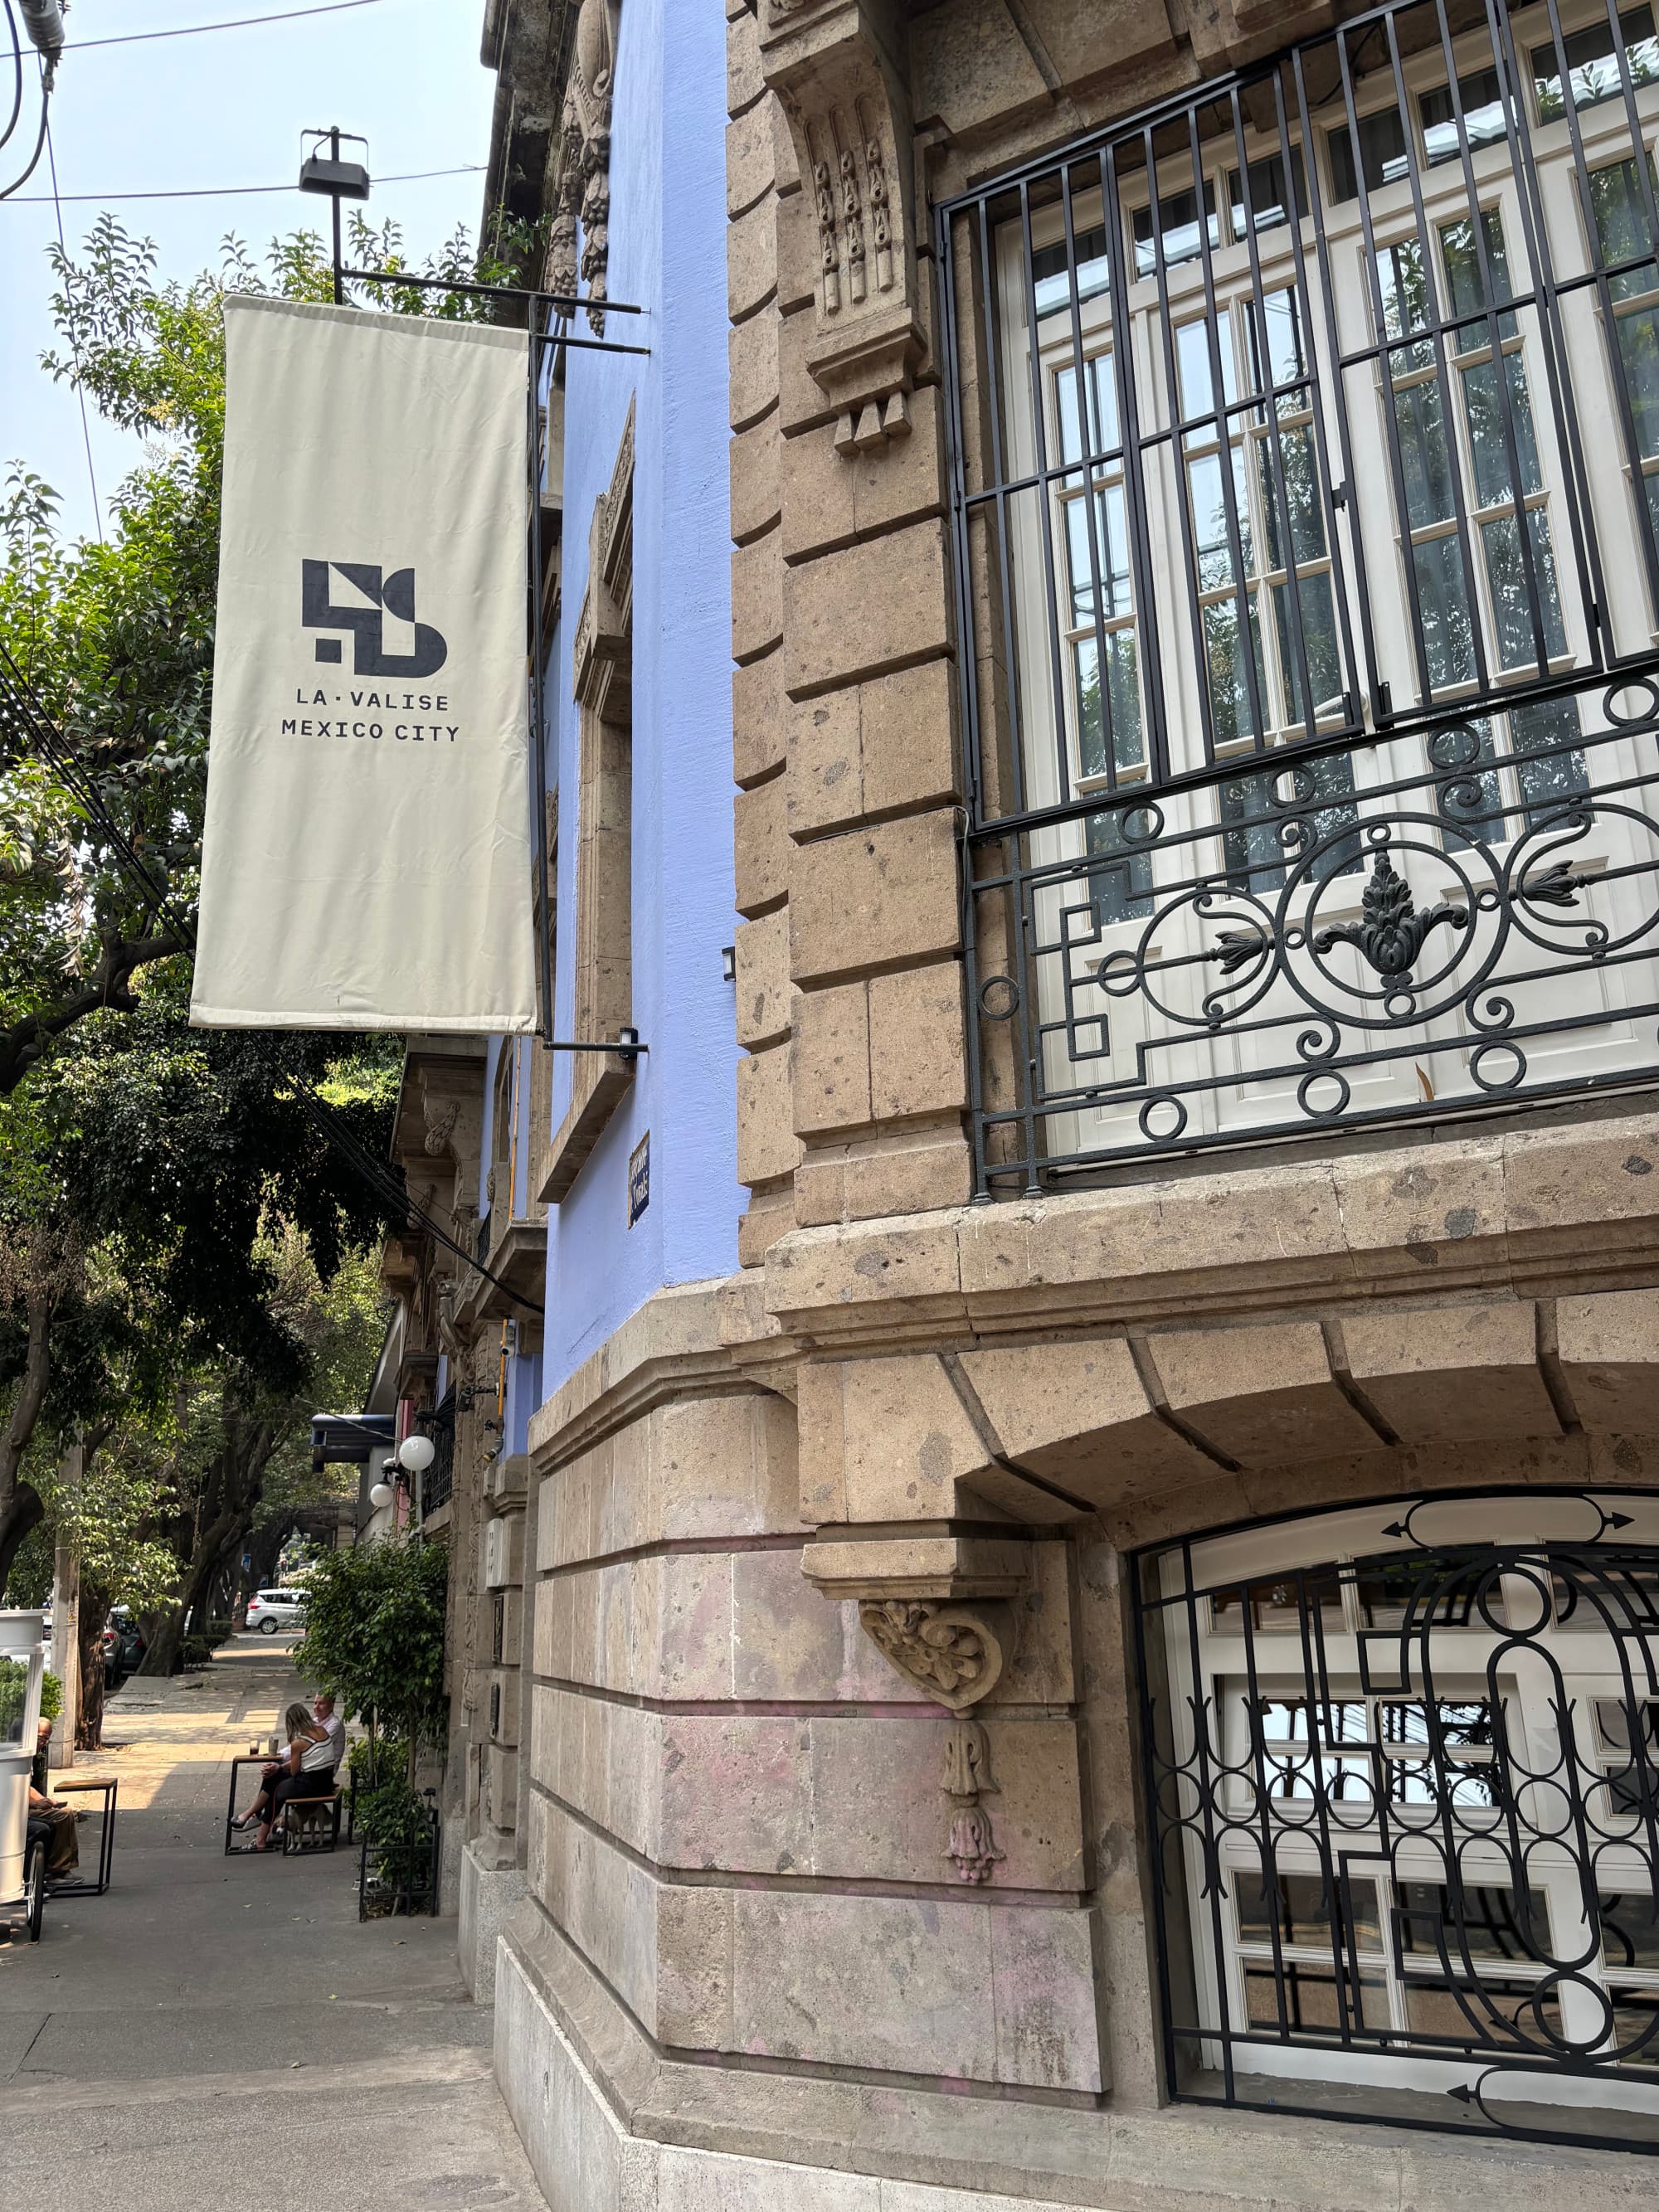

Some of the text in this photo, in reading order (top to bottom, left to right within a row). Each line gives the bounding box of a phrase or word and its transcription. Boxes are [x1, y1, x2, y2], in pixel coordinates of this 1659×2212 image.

[350, 691, 448, 712] VALISE
[281, 719, 460, 742] MEXICO CITY
